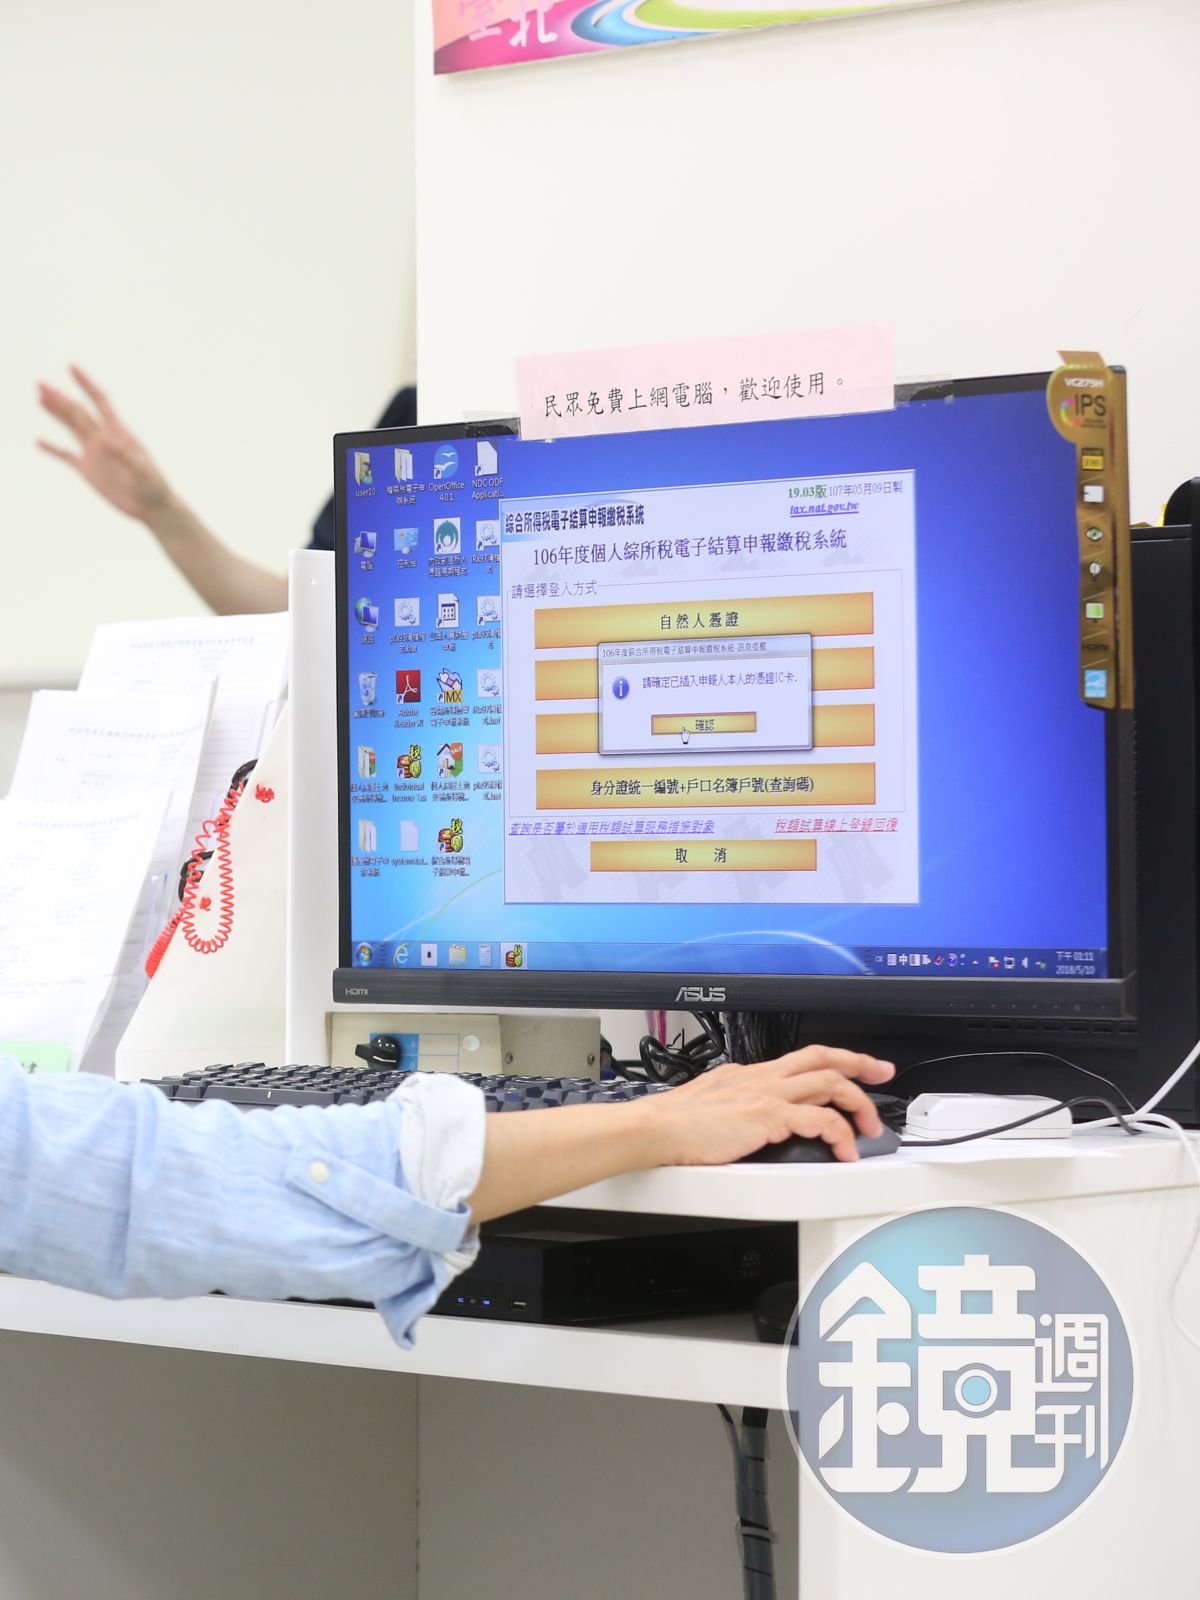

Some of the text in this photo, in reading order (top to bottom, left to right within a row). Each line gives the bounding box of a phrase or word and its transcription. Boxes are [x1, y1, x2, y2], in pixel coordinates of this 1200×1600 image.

[544, 372, 844, 418] 民眾免費上網電腦，歡迎使用。
[1075, 393, 1106, 416] IPS
[429, 481, 465, 492] OpenOffice
[790, 501, 860, 517] tax.nat.gov.tw
[533, 528, 847, 566] 106年度個人綜所稅電子結算申報繳稅系統
[511, 579, 597, 599] 請選擇登入方式
[660, 611, 739, 630] 自然人憑證
[695, 719, 715, 732] 確認
[590, 776, 814, 796] 身分證統一編號+戶口名簿戶號(查詢碼)
[345, 987, 368, 995] HDMI
[675, 986, 726, 1002] ASUS
